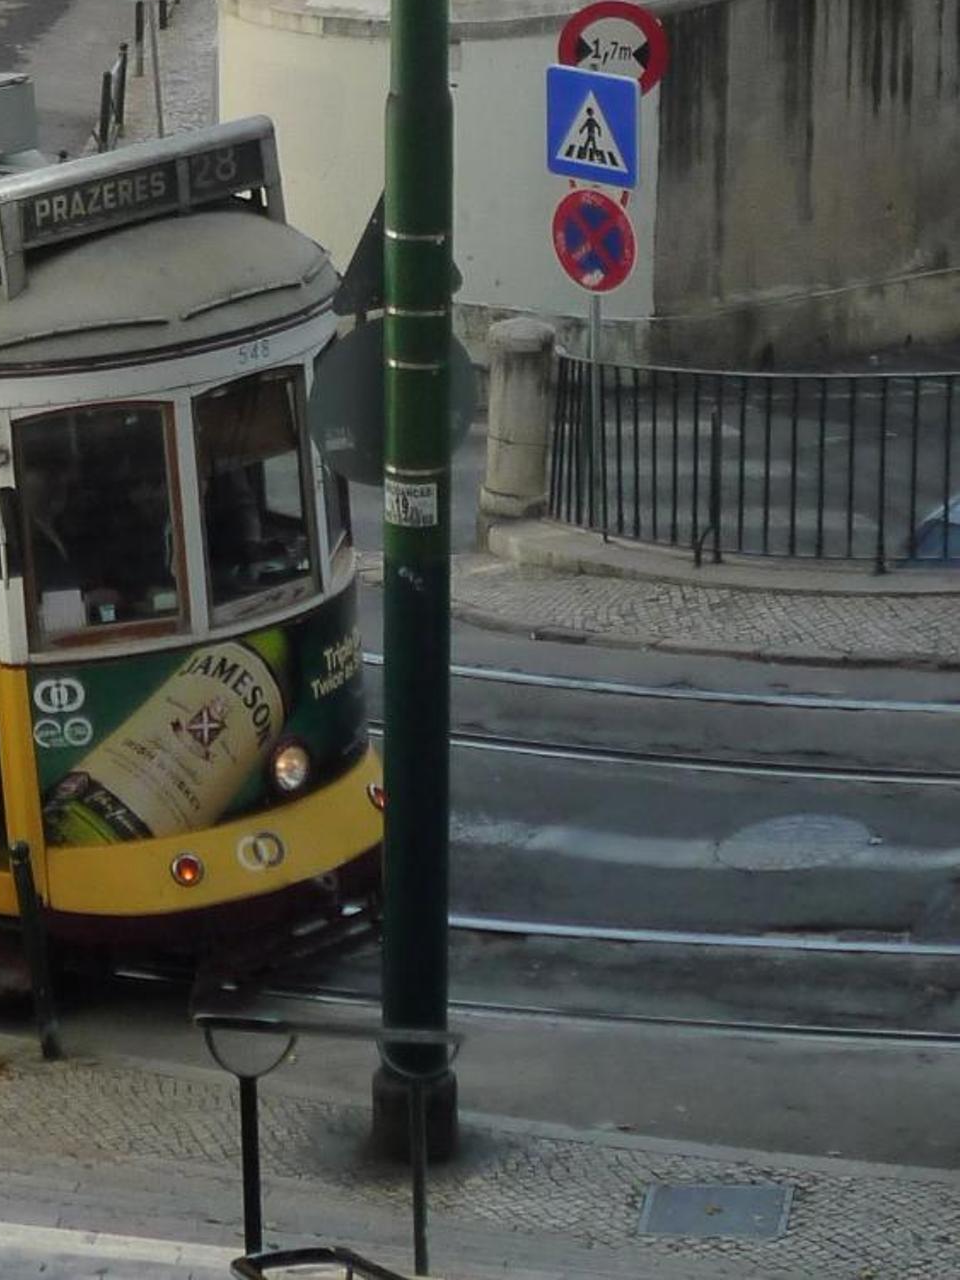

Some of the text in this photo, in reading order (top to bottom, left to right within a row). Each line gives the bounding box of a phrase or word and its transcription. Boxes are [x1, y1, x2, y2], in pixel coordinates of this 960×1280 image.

[591, 38, 632, 65] 1,7m
[34, 147, 237, 226] PRAZERES 28
[239, 340, 270, 365] 548
[180, 654, 272, 750] JAMESON
